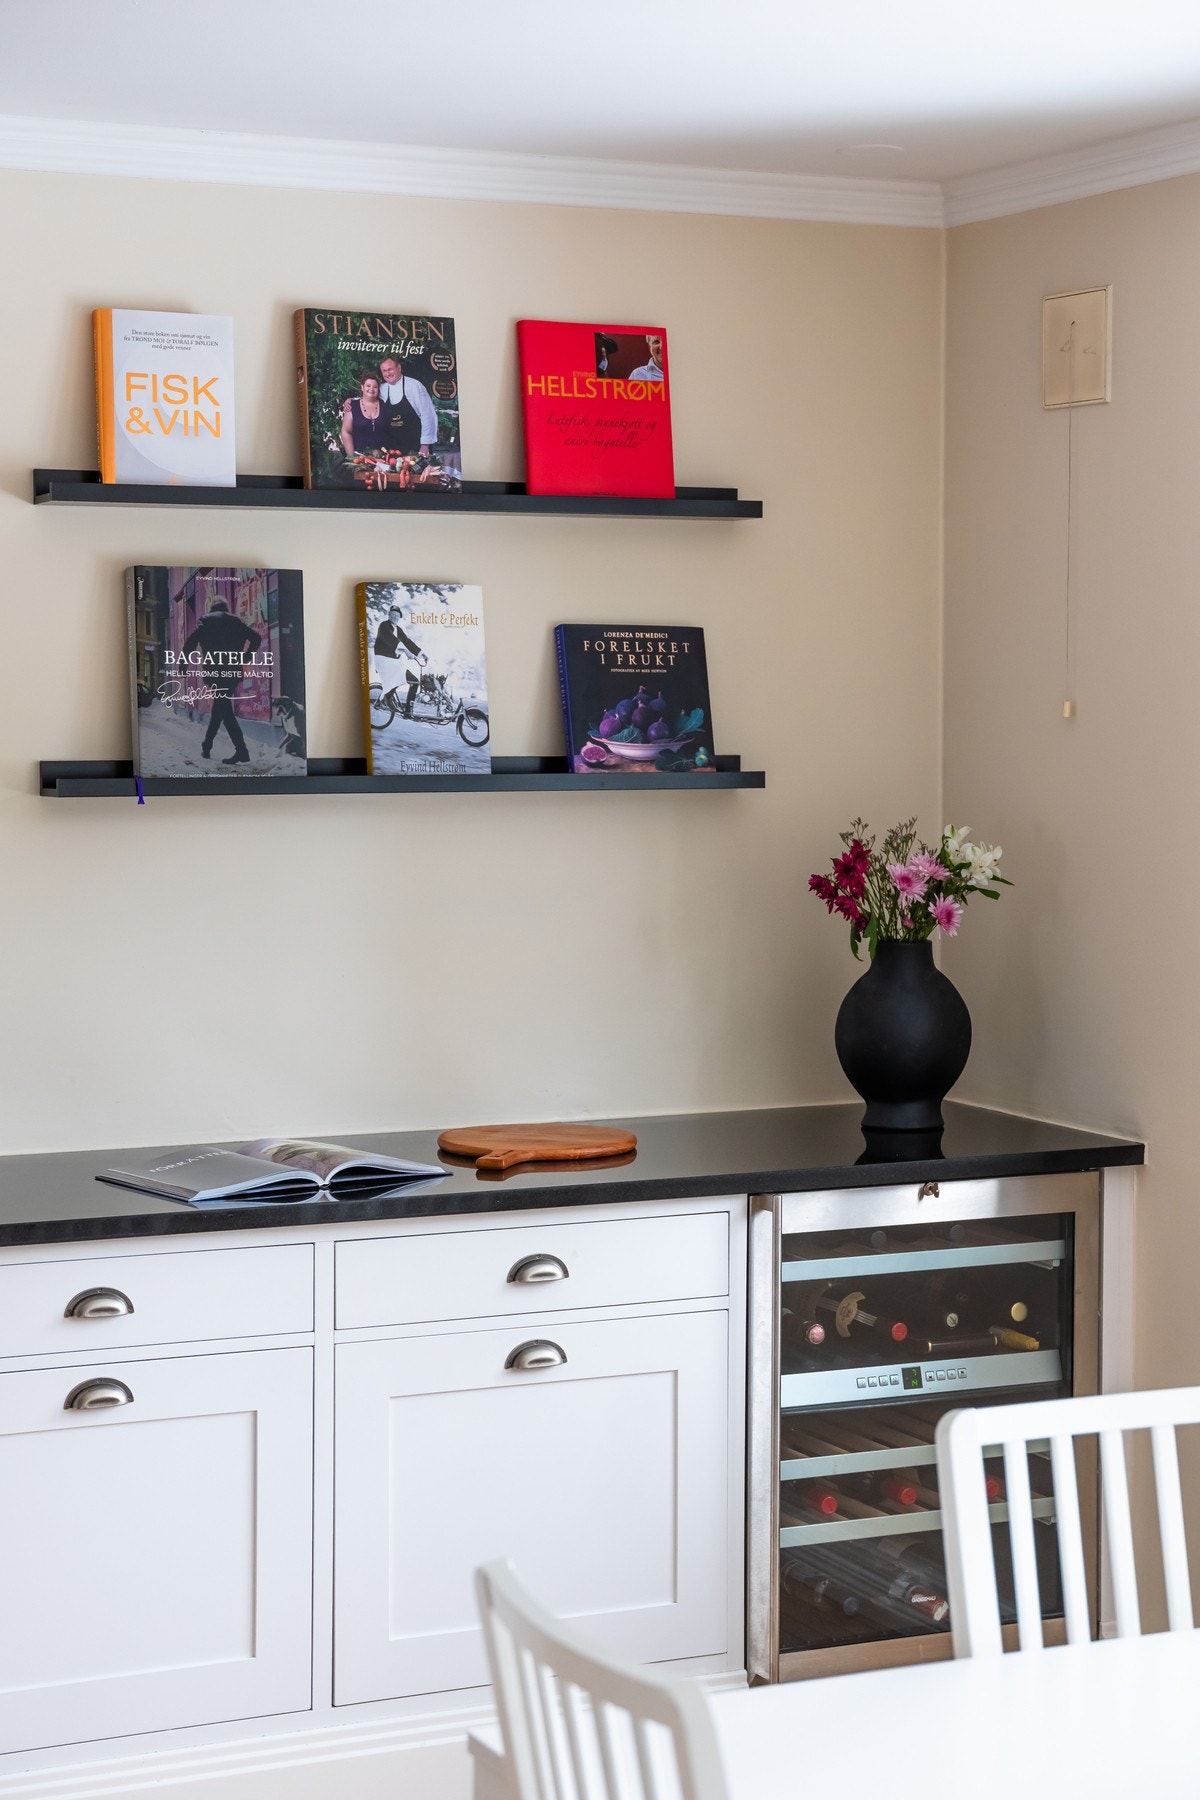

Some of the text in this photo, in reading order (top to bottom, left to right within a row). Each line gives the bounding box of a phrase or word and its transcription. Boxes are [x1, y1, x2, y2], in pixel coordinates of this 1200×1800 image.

[314, 313, 445, 341] STIANSEN
[337, 338, 425, 359] inviterer til fest
[125, 372, 220, 406] FISK
[528, 375, 665, 401] HELLSTRØM
[410, 612, 479, 626] Enkelt & Perfekt
[584, 640, 690, 653] FORELSKET
[164, 650, 275, 666] BAGATELLE
[601, 653, 676, 666] I FRUKT
[166, 670, 219, 678] HELLSTRØMS
[244, 669, 274, 679] MÅLTID
[400, 760, 467, 775] Eyvind Hellstrøm
